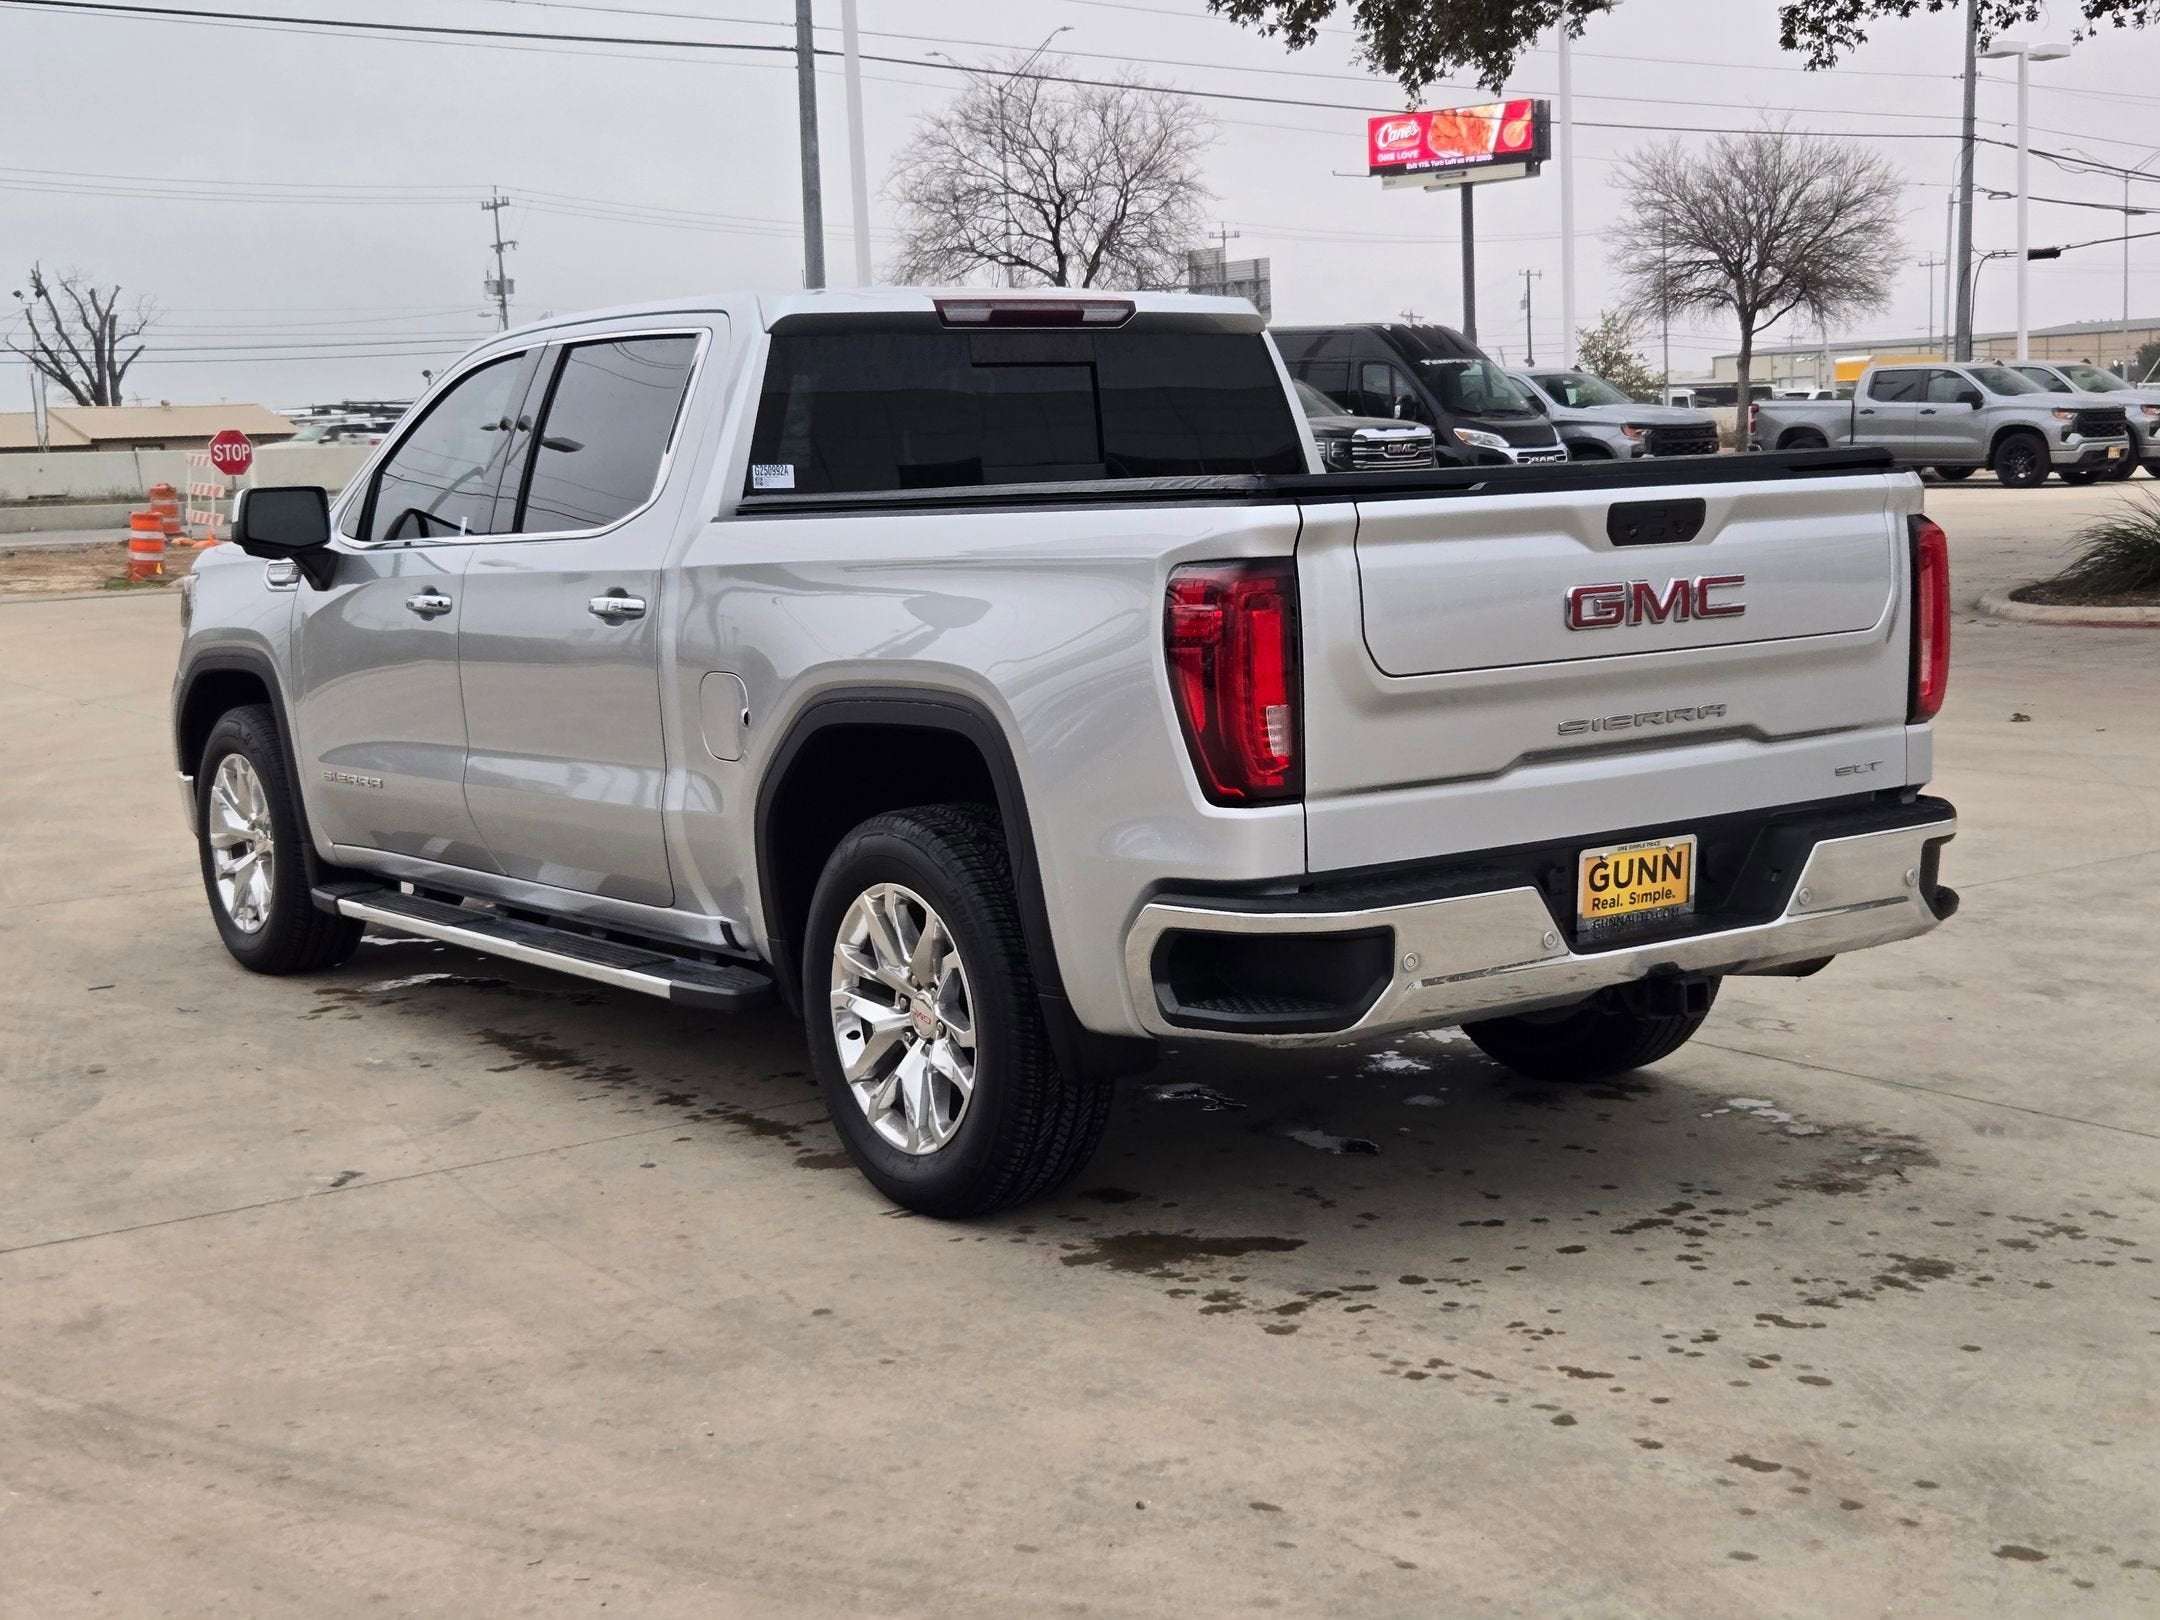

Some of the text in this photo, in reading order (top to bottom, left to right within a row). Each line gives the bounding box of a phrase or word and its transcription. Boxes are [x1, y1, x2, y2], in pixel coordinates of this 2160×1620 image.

[1378, 119, 1419, 148] Cane's
[1377, 150, 1419, 162] ONE LOVE
[1445, 158, 1456, 166] Left
[213, 444, 250, 462] STOP
[1388, 444, 1416, 453] GMC
[1565, 574, 1746, 630] GMC
[1557, 703, 1728, 736] SIERRA
[1834, 760, 1883, 776] SLT
[323, 771, 384, 789] SIERRA
[1588, 851, 1683, 893] GUNN
[1592, 893, 1623, 911] Real.
[1592, 906, 1680, 929] GUNNAUTO.COM
[911, 1008, 932, 1025] GMC
